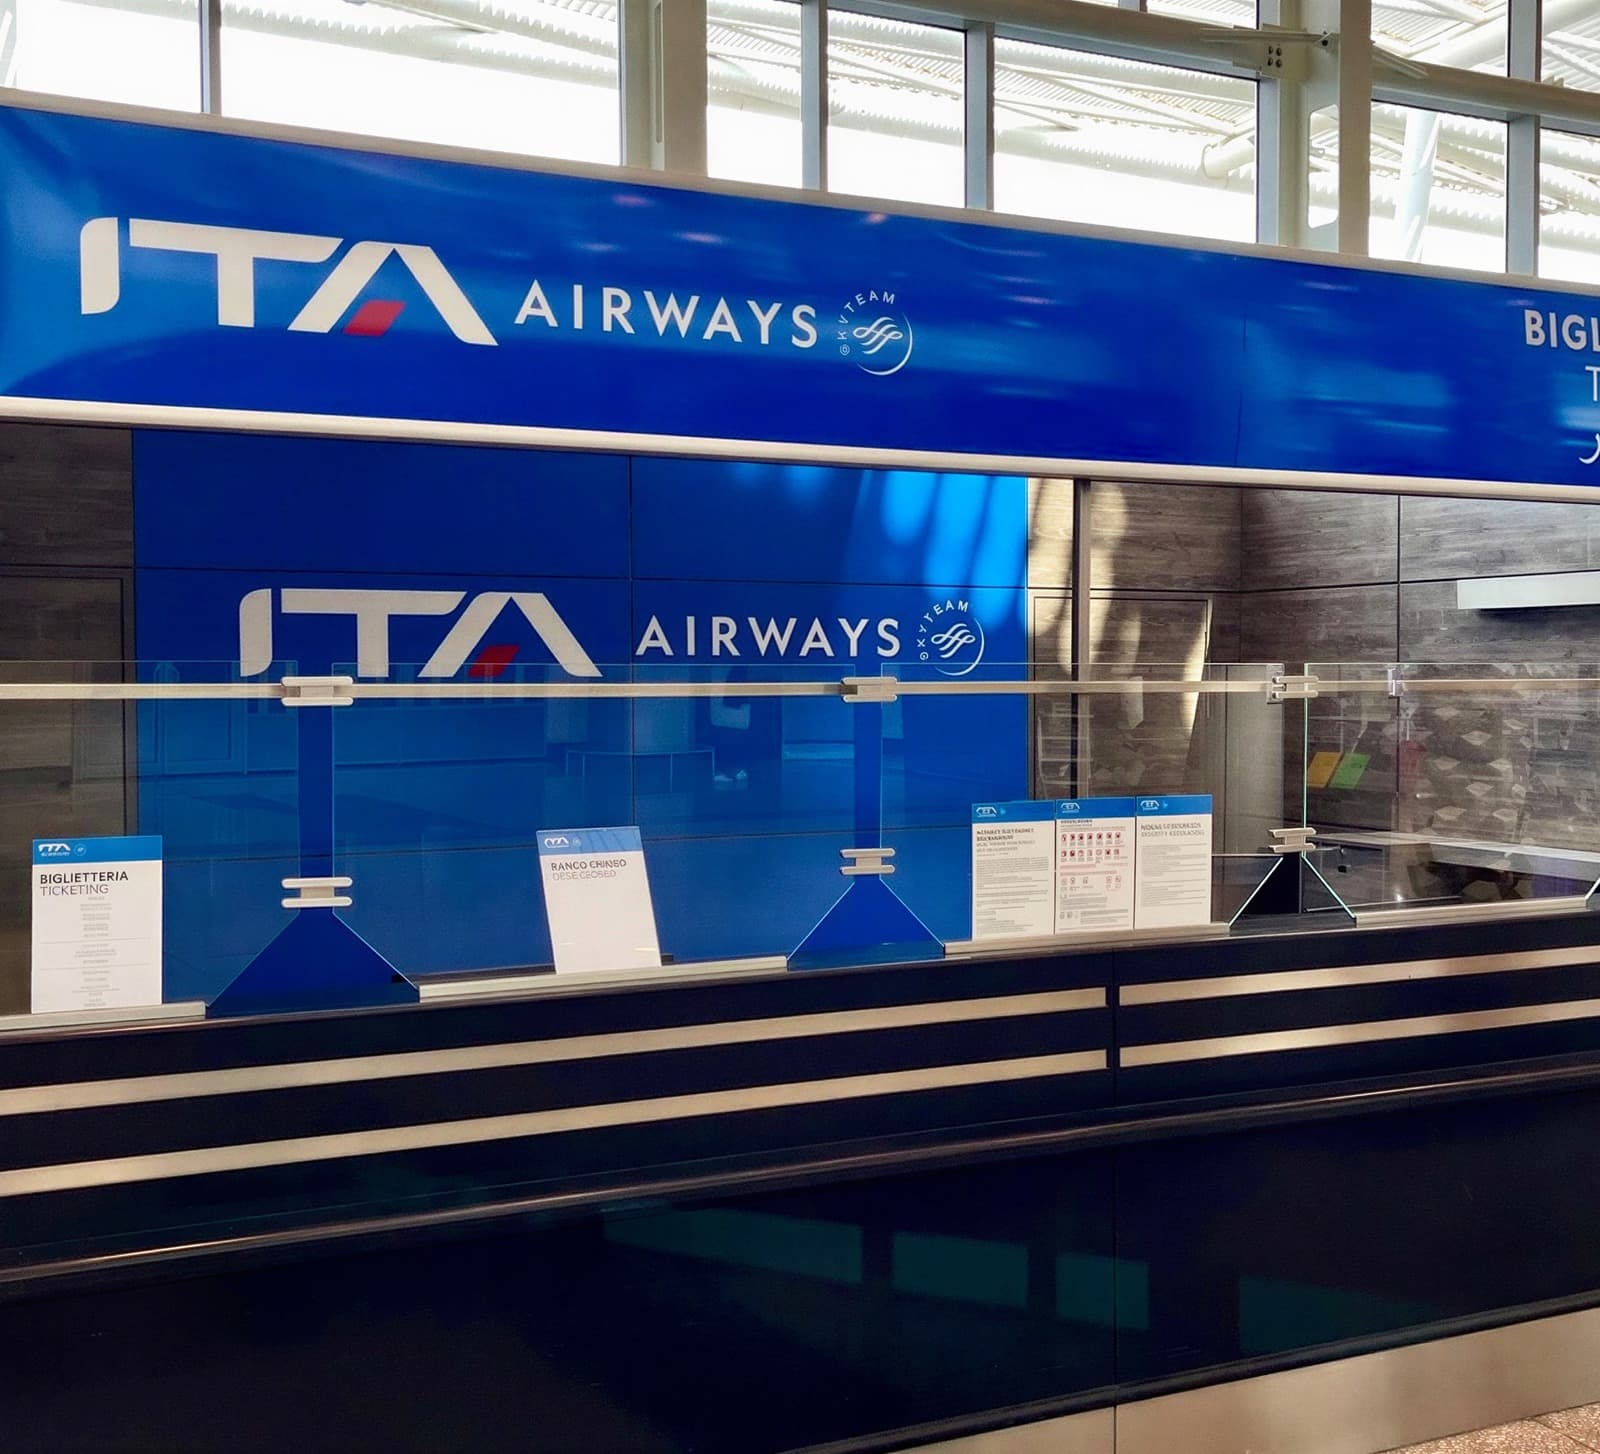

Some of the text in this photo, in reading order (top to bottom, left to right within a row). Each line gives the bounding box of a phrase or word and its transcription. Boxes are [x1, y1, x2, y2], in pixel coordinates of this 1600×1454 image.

[80, 217, 818, 349] ITA AIRWAYS
[239, 588, 900, 678] ITA AIRWAYS
[40, 871, 129, 885] BIGLIETTERIA
[40, 884, 109, 897] TICKETING
